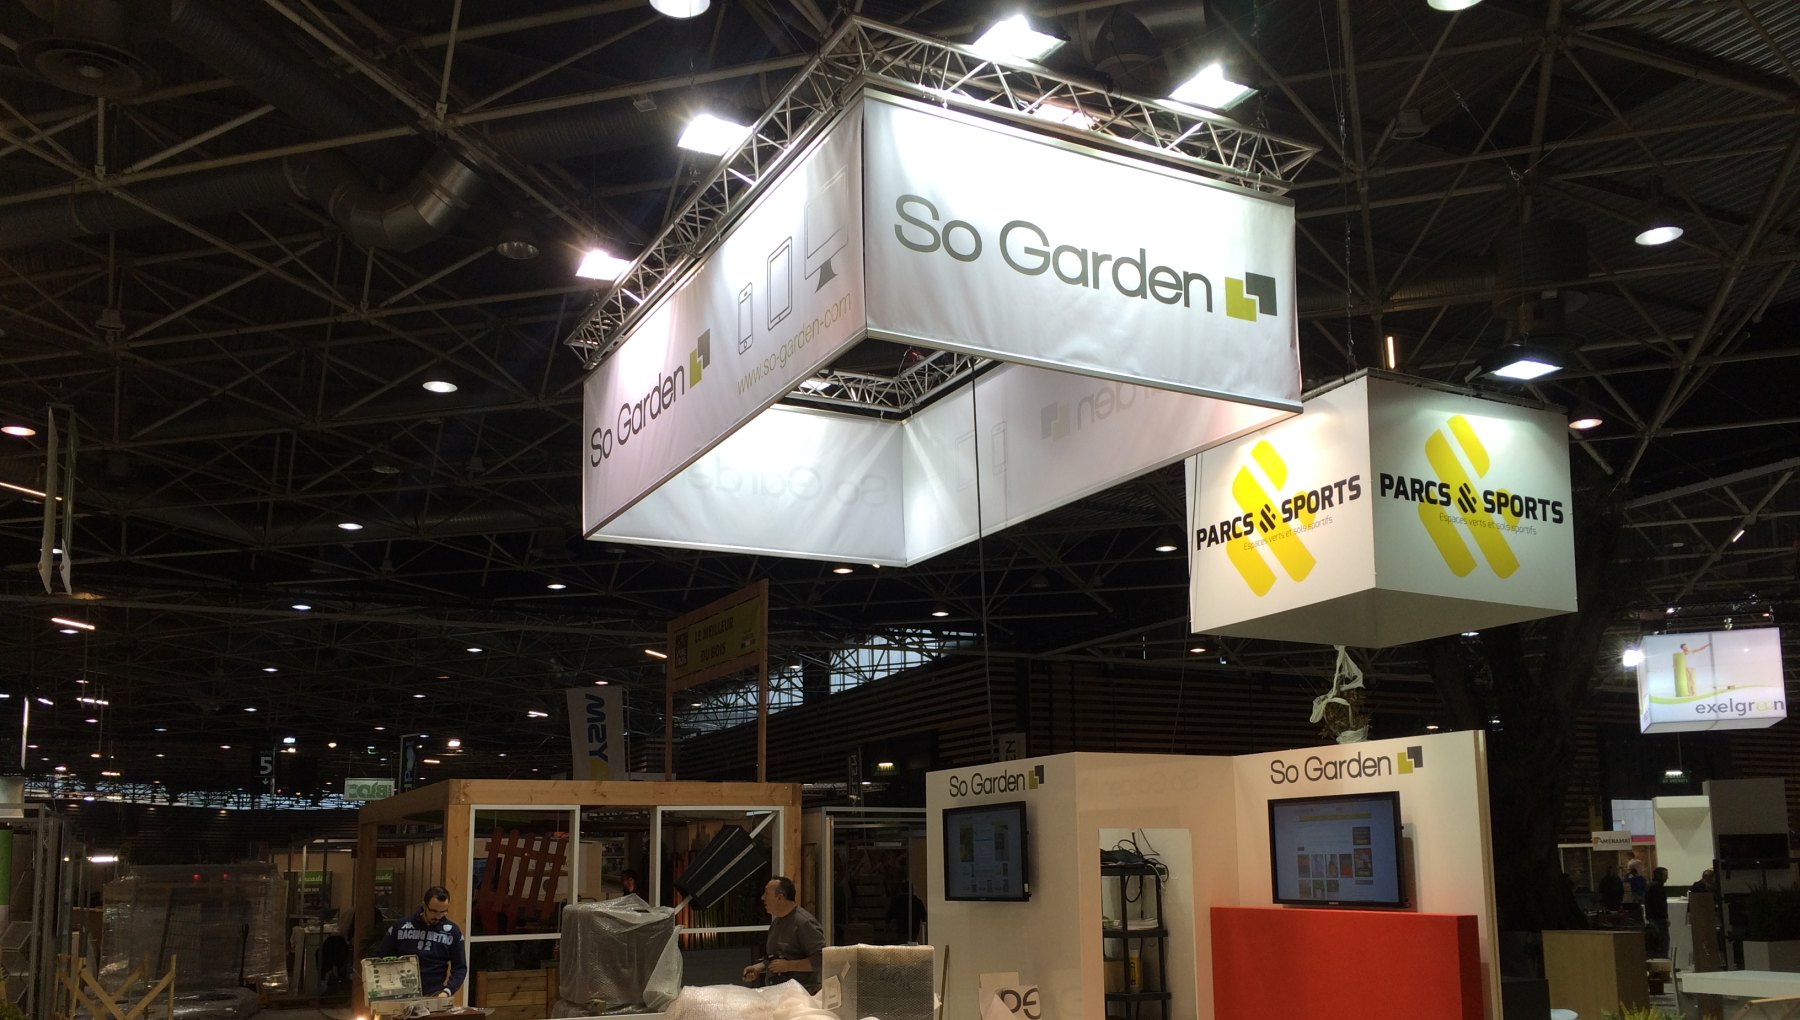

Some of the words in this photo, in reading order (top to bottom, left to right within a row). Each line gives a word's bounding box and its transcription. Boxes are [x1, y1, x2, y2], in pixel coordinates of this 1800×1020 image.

[894, 194, 983, 263] So
[999, 219, 1214, 313] Garden
[590, 426, 612, 467] So
[617, 362, 685, 446] Garden
[1196, 511, 1254, 551] PARCS
[1281, 474, 1362, 524] SPORTS
[1379, 472, 1451, 507] PARCS
[1483, 489, 1564, 525] SPORTS
[1243, 536, 1267, 552] Espaces
[1268, 532, 1285, 544] verts
[1285, 528, 1292, 538] et
[1293, 523, 1307, 537] sols
[1307, 514, 1333, 535] sportifs
[1439, 512, 1467, 528] Espaces
[1468, 516, 1487, 527] verts
[1487, 518, 1496, 528] et
[1496, 520, 1510, 532] sols
[1510, 522, 1537, 537] sportifs
[702, 616, 734, 641] MEILLEUR
[710, 641, 726, 658] BOIS
[259, 756, 273, 775] 5
[1270, 759, 1298, 785] So
[1304, 753, 1393, 782] Garden
[949, 774, 969, 798] So
[971, 770, 1026, 796] Garden
[397, 929, 426, 941] RACING
[426, 930, 454, 946] METRO
